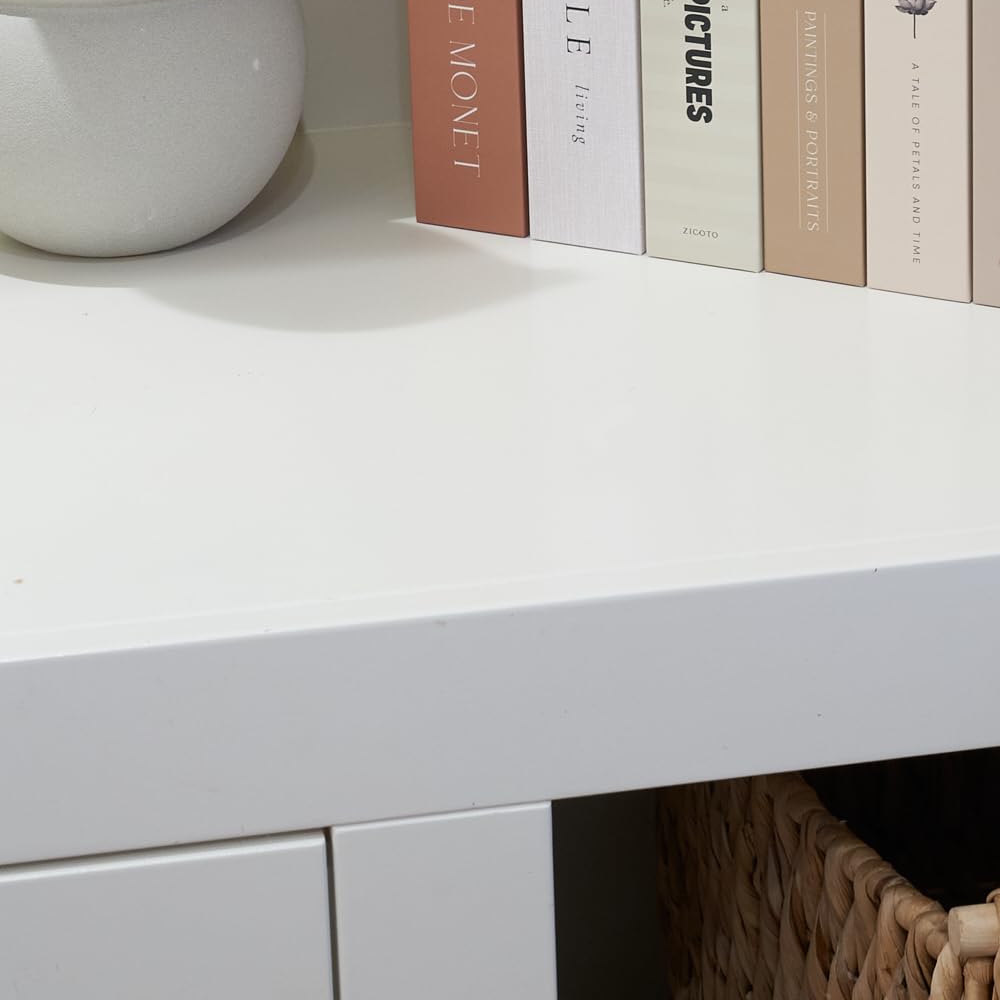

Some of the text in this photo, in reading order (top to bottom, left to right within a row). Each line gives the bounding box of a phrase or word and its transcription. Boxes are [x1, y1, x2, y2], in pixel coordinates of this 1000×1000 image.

[720, 3, 730, 13] a
[449, 40, 481, 178] MONET
[571, 84, 590, 145] living
[804, 10, 820, 231] PAINTINGS & PORTRAITS
[911, 62, 921, 264] A TALE OF PETALS AND TIME
[682, 227, 719, 239] ZICOTO
